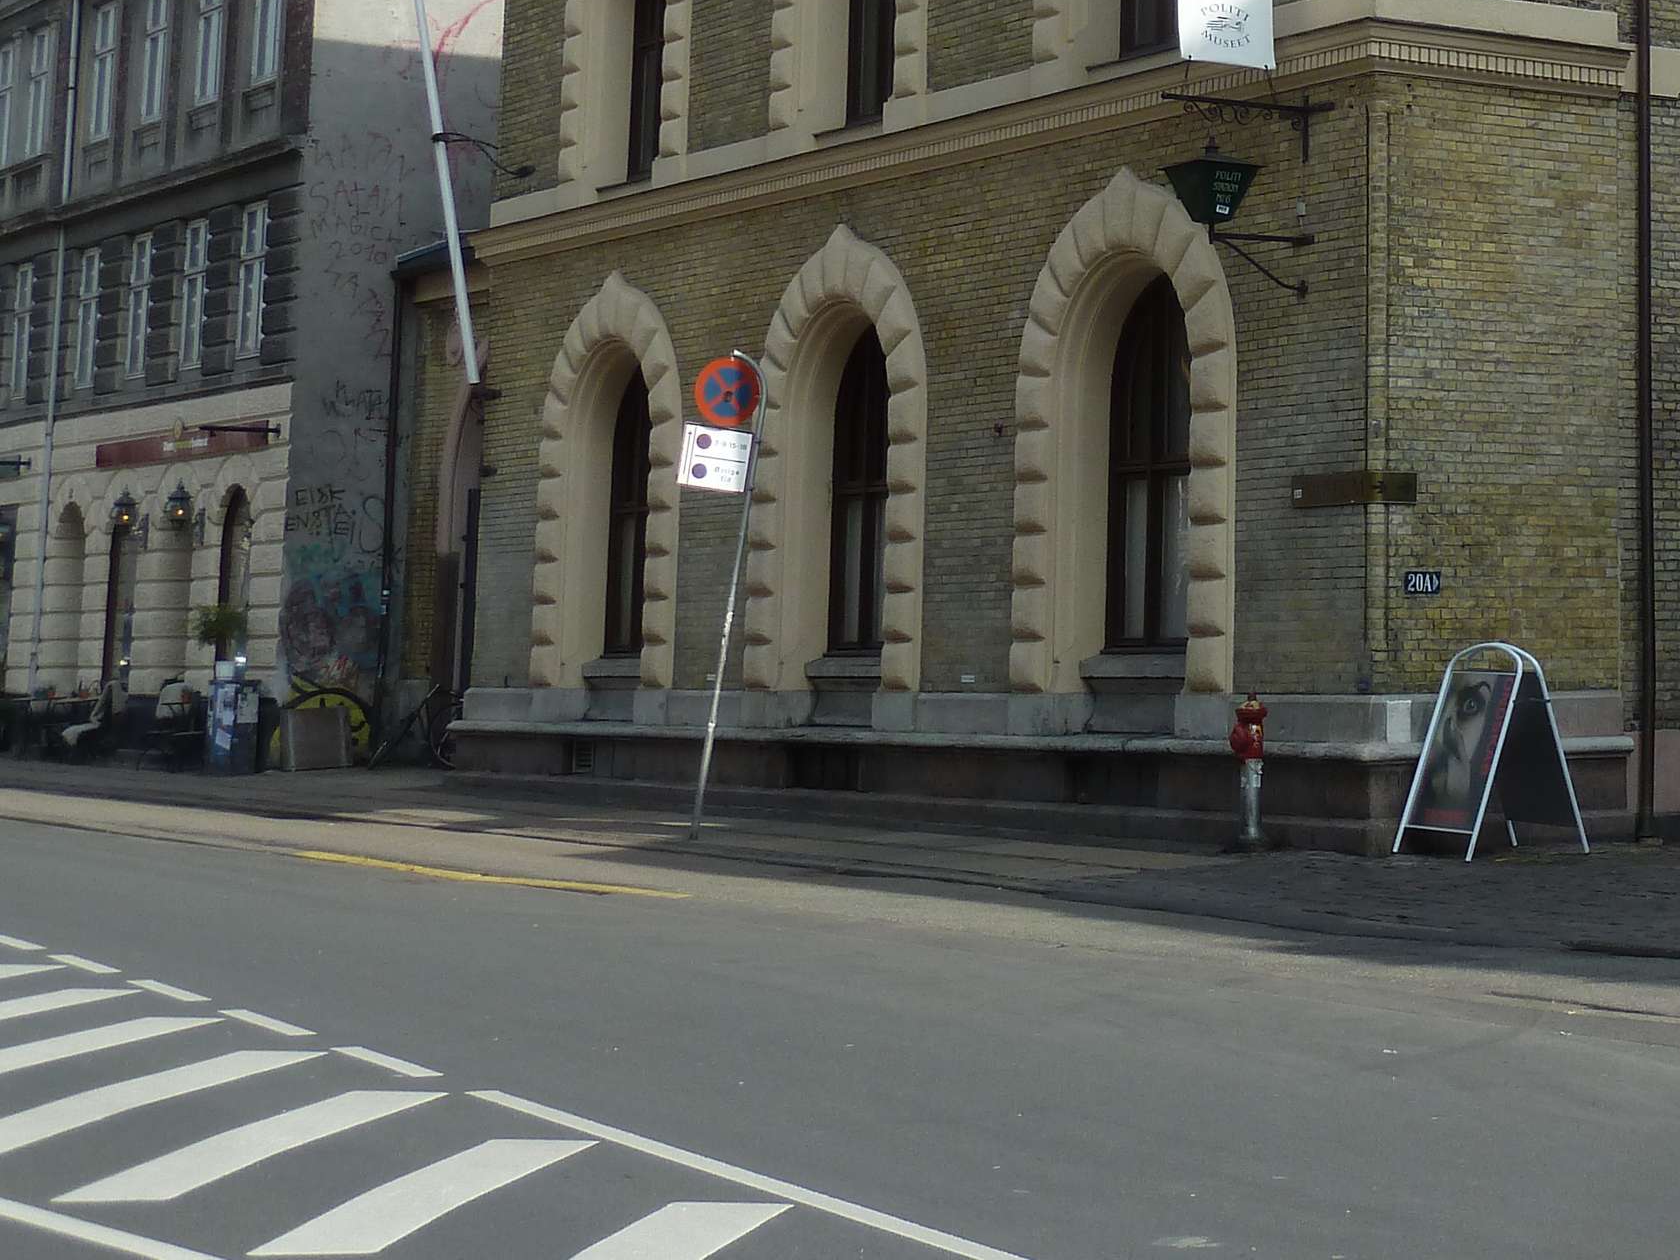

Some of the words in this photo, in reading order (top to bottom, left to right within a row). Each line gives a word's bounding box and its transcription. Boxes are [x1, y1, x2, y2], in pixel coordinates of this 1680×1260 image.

[1200, 3, 1249, 22] POLITI
[1200, 25, 1251, 48] MUSEET
[1408, 573, 1433, 592] 20A
